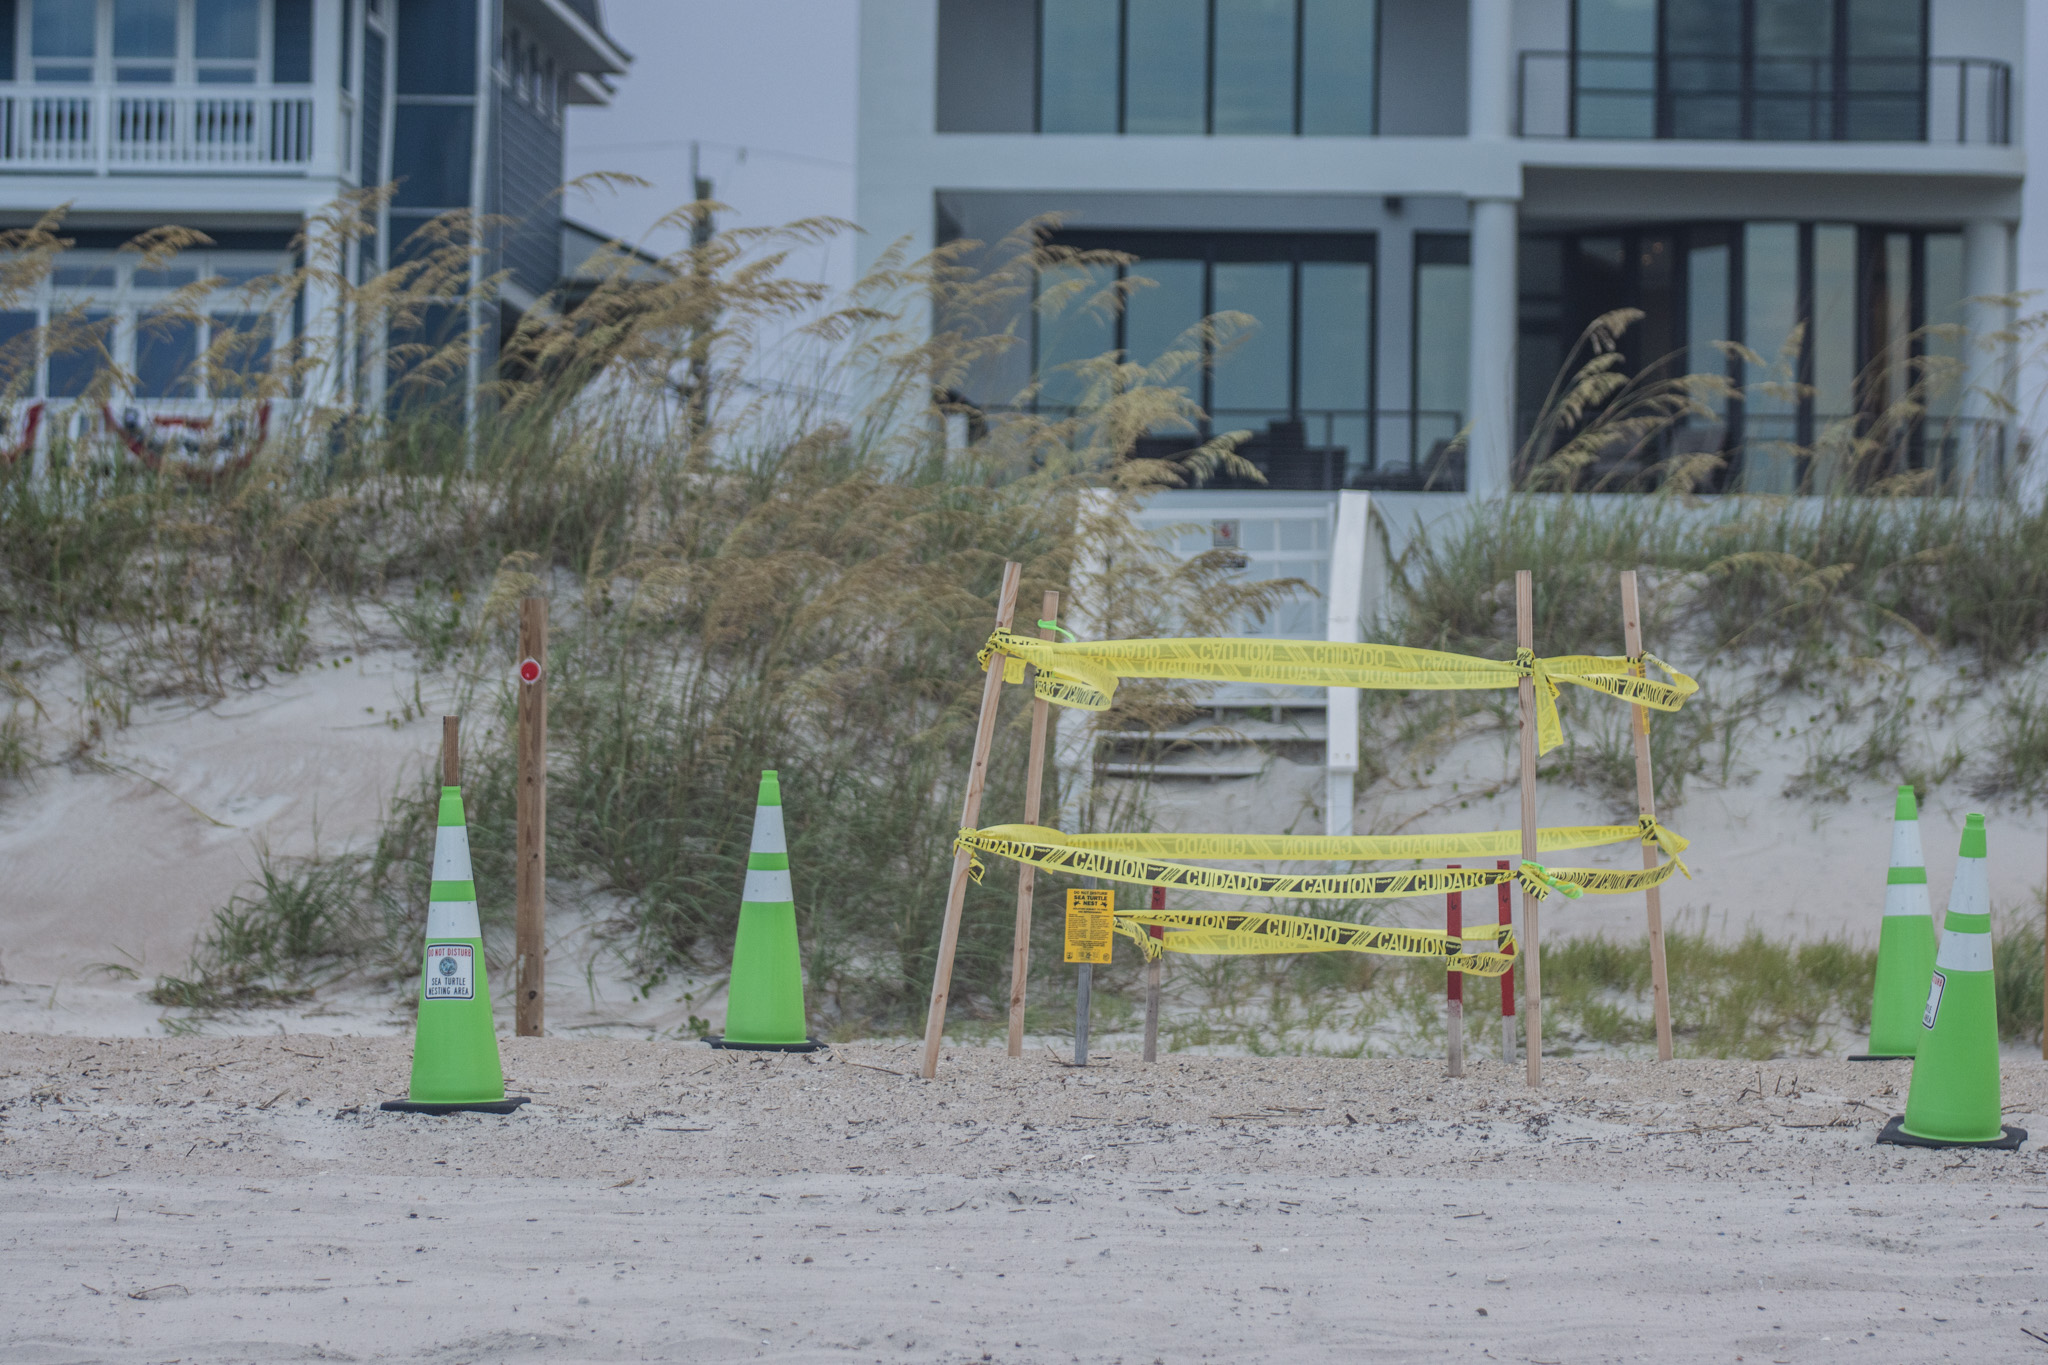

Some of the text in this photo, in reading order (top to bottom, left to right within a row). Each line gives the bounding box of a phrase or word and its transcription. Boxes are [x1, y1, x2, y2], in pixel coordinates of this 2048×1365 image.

[1073, 850, 1148, 879] CAUTION
[1186, 869, 1262, 892] CUIDADO
[1301, 877, 1376, 894] CAUTION
[1415, 872, 1487, 891] CUIDADO
[1266, 918, 1340, 943] CUIDADO
[1377, 931, 1447, 956] CAUTION
[429, 948, 471, 957] DO NOT DISTURB
[429, 987, 469, 995] NESTING AREA
